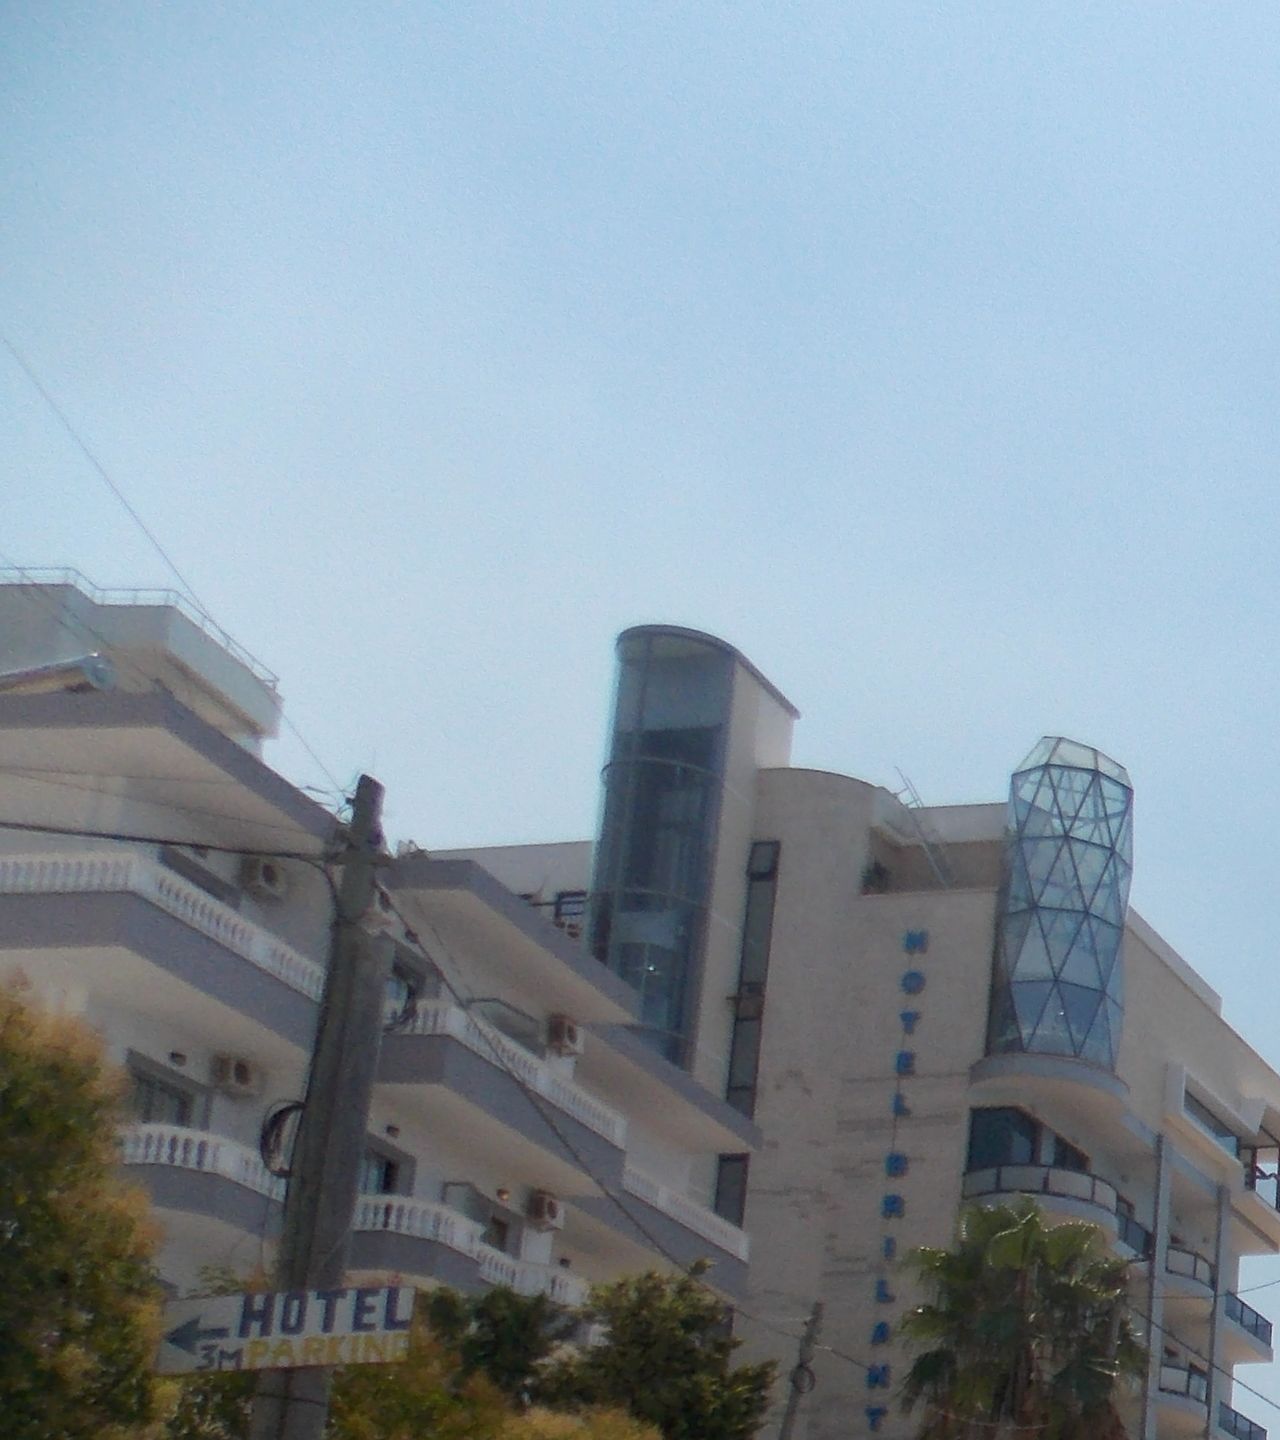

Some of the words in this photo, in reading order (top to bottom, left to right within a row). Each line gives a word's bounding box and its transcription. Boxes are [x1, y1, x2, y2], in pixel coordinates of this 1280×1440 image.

[894, 928, 929, 1117] HOTEL
[241, 1287, 409, 1337] HOTEL
[865, 1152, 909, 1432] BRILANT
